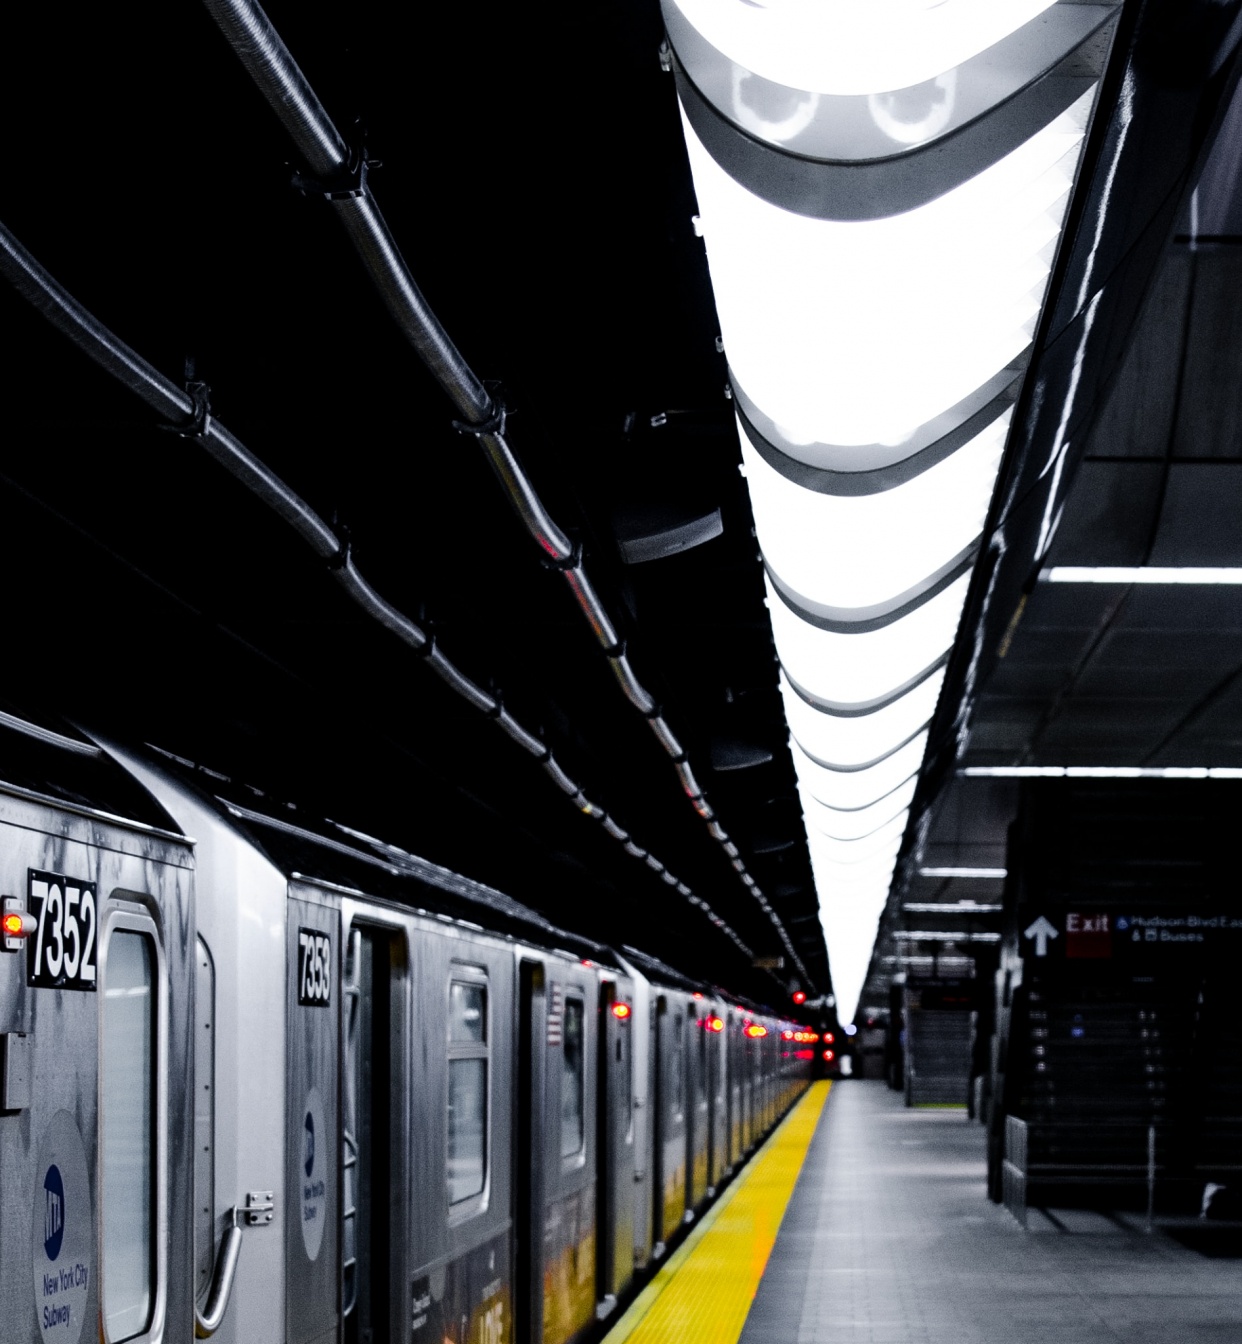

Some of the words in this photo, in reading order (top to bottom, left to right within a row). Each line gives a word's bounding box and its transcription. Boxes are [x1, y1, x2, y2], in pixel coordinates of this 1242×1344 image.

[31, 879, 96, 981] 7352
[1066, 913, 1109, 932] Exit
[1131, 915, 1184, 927] Hudson
[1187, 914, 1217, 927] Blvd
[1220, 915, 1242, 927] Eas
[1160, 928, 1204, 942] Buses
[300, 932, 330, 1000] 7353
[44, 1188, 62, 1242] MTA
[43, 1273, 59, 1297] New
[59, 1268, 75, 1292] York
[75, 1263, 89, 1291] City
[43, 1303, 71, 1331] Subway
